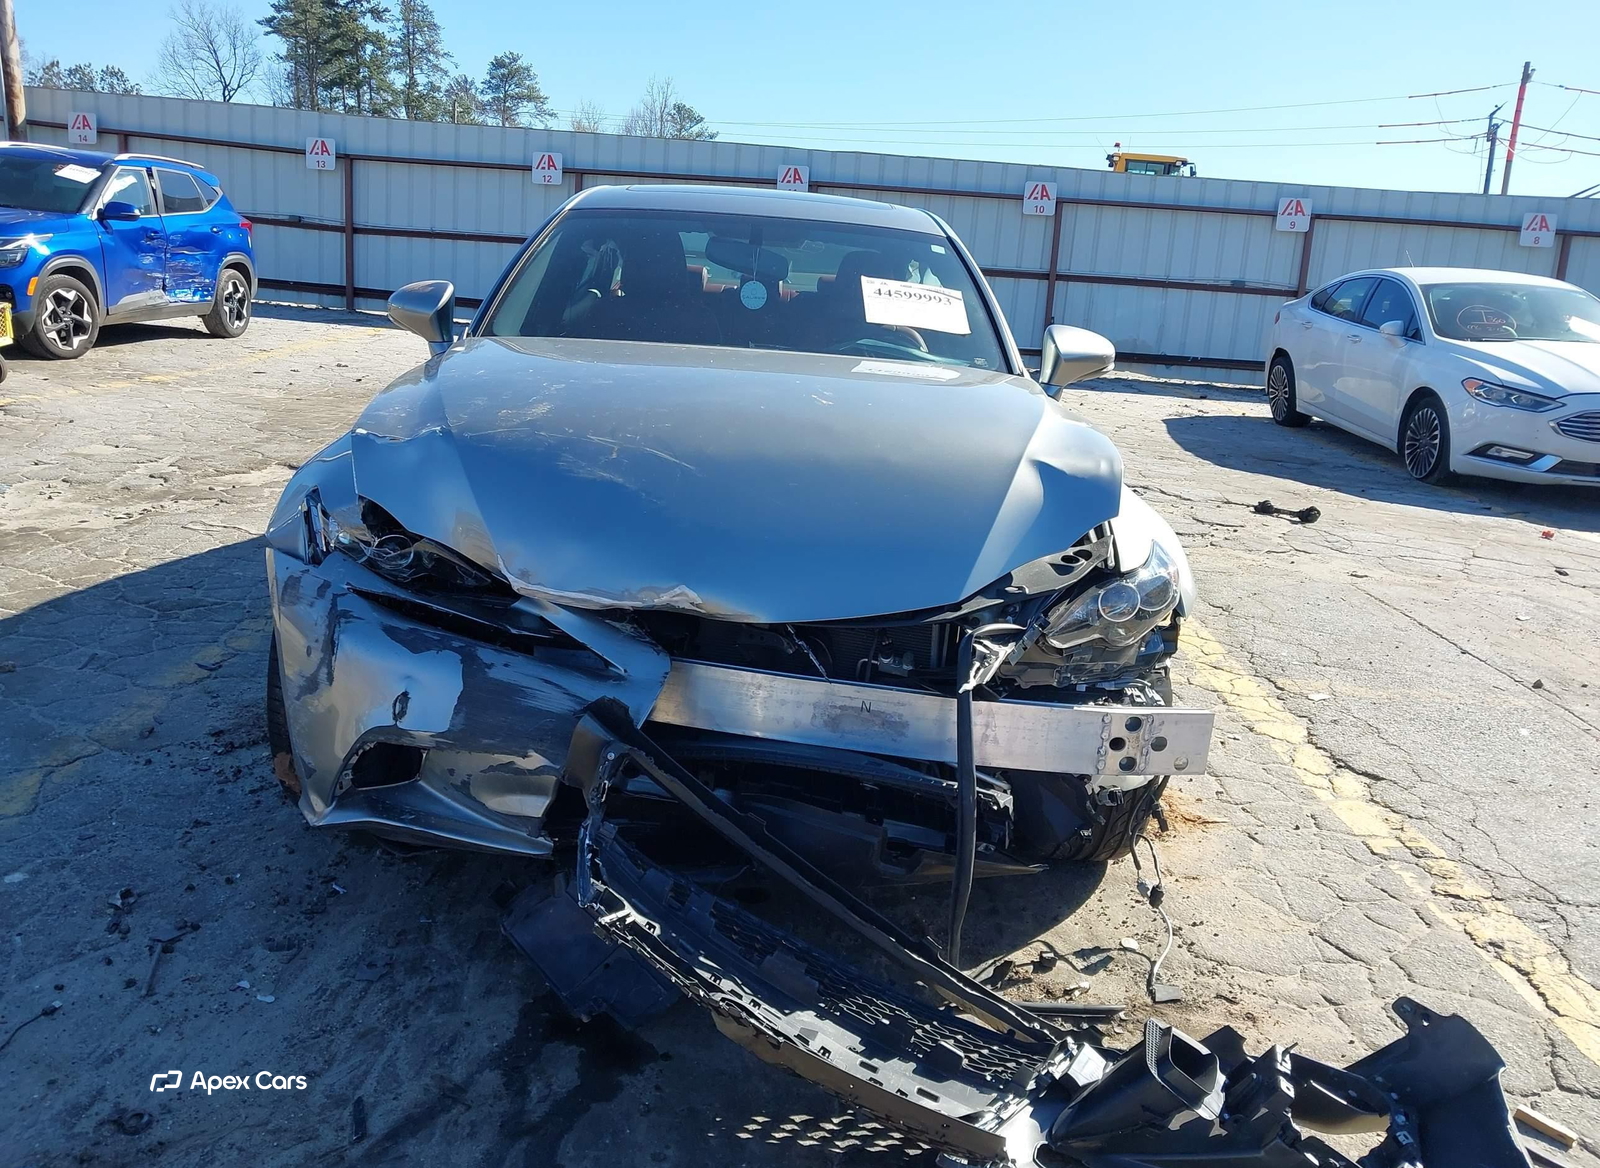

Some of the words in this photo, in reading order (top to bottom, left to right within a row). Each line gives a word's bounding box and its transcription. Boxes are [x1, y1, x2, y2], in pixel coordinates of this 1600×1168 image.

[78, 134, 88, 142] 14
[316, 160, 326, 168] 13
[542, 175, 552, 183] 12
[1034, 205, 1045, 213] 10
[1289, 221, 1296, 229] 9
[1533, 236, 1540, 244] 8
[873, 287, 952, 306] 44599993
[861, 700, 872, 713] N
